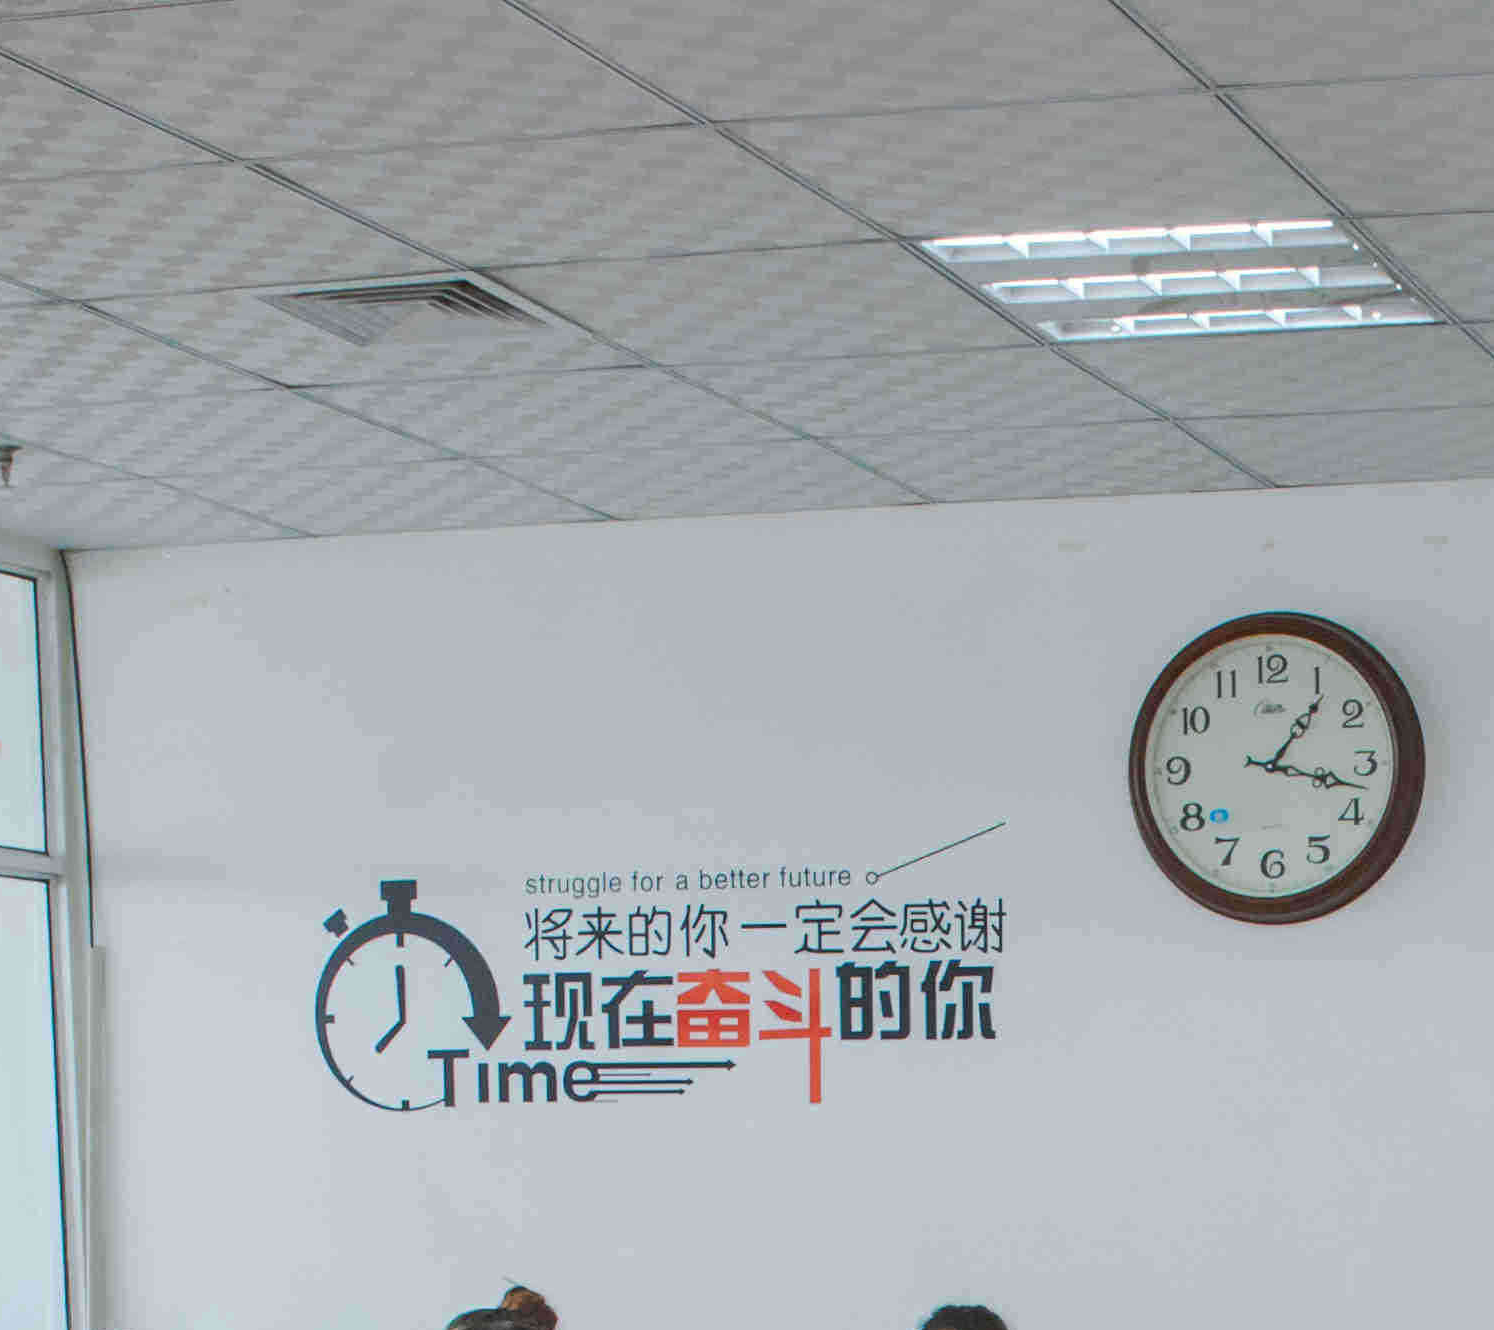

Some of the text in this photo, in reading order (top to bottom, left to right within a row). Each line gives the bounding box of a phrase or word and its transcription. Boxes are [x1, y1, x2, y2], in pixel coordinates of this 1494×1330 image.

[1216, 669, 1238, 699] 11
[1258, 654, 1289, 685] 12
[1313, 666, 1321, 695] 1
[1182, 706, 1211, 735] 10
[1341, 699, 1365, 729] 2
[1166, 756, 1192, 786] 9
[1354, 750, 1378, 776] 3
[1180, 803, 1206, 832] 8
[1338, 797, 1365, 826] 4
[1214, 836, 1241, 866] 7
[1260, 849, 1286, 879] 6
[1306, 835, 1331, 864] 5
[525, 866, 851, 898] struggle for a better future
[524, 897, 1007, 960] 将来的你一定会感谢
[523, 959, 997, 1105] 现在奋斗的你
[427, 1048, 601, 1107] Time
